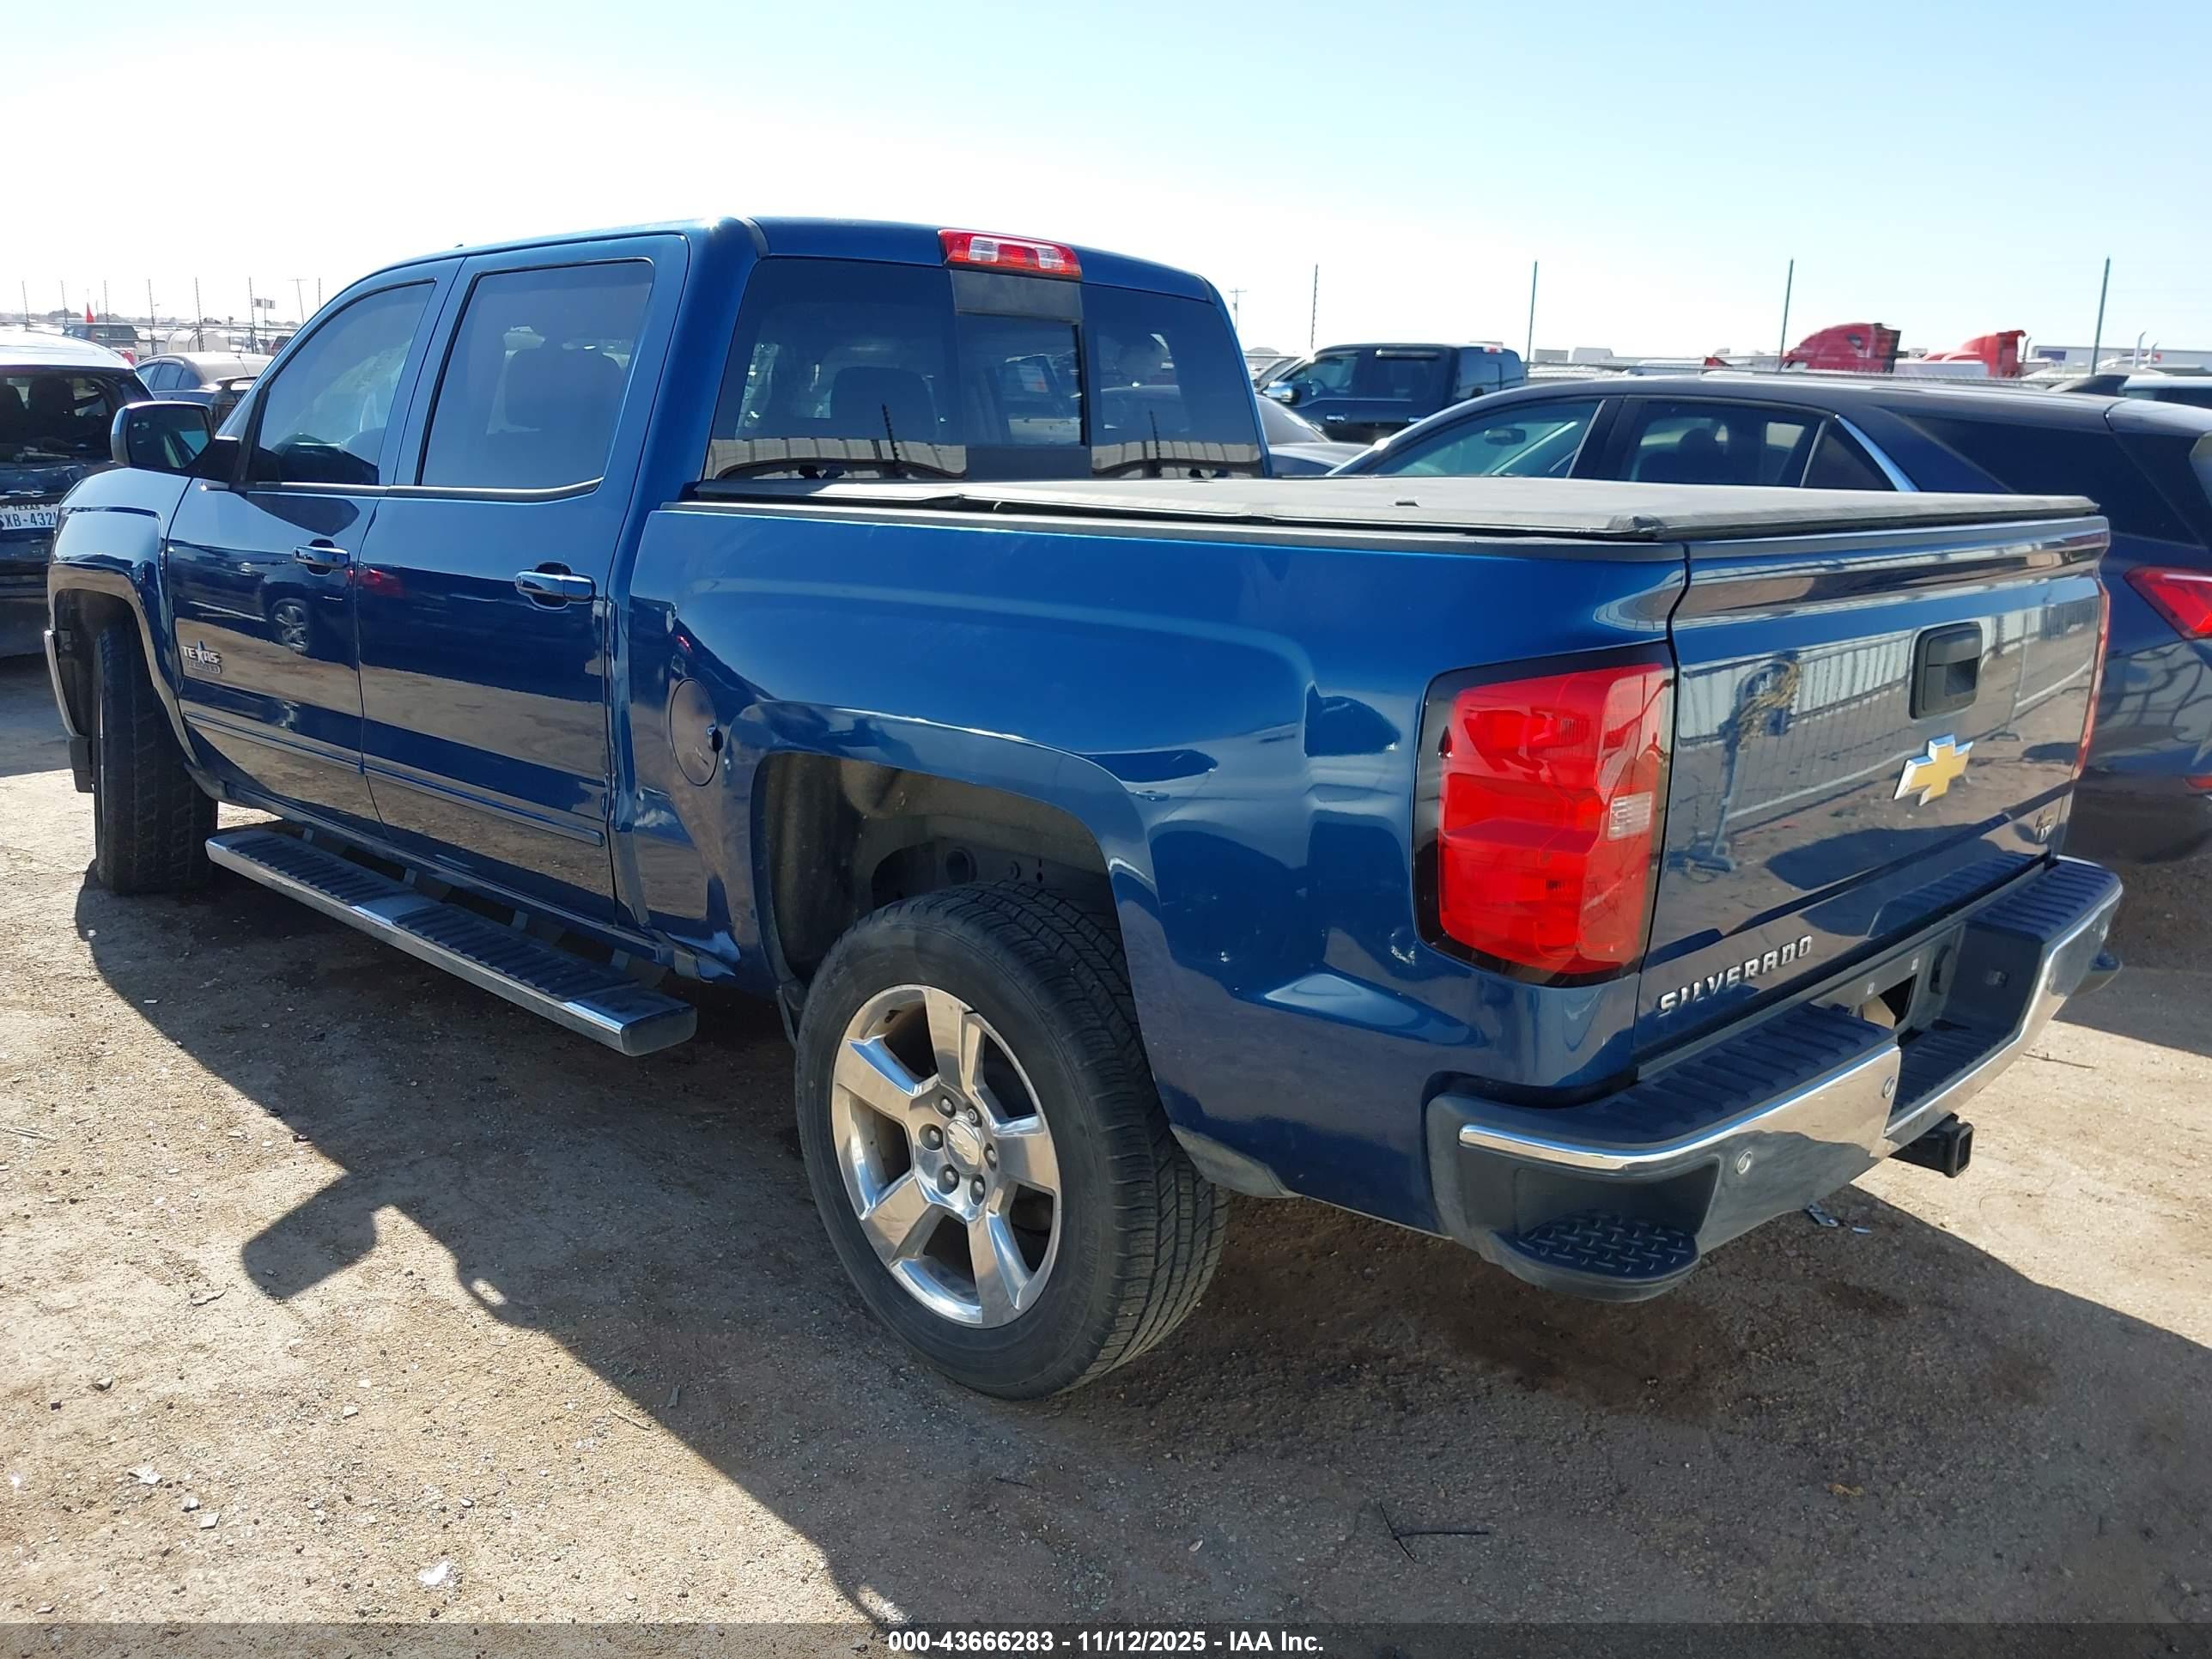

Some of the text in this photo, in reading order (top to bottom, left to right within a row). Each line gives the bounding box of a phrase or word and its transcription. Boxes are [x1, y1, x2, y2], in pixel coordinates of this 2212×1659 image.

[13, 502, 40, 511] TEXAS
[181, 645, 221, 665] TEXAS
[1657, 935, 1813, 1018] SILVERADO
